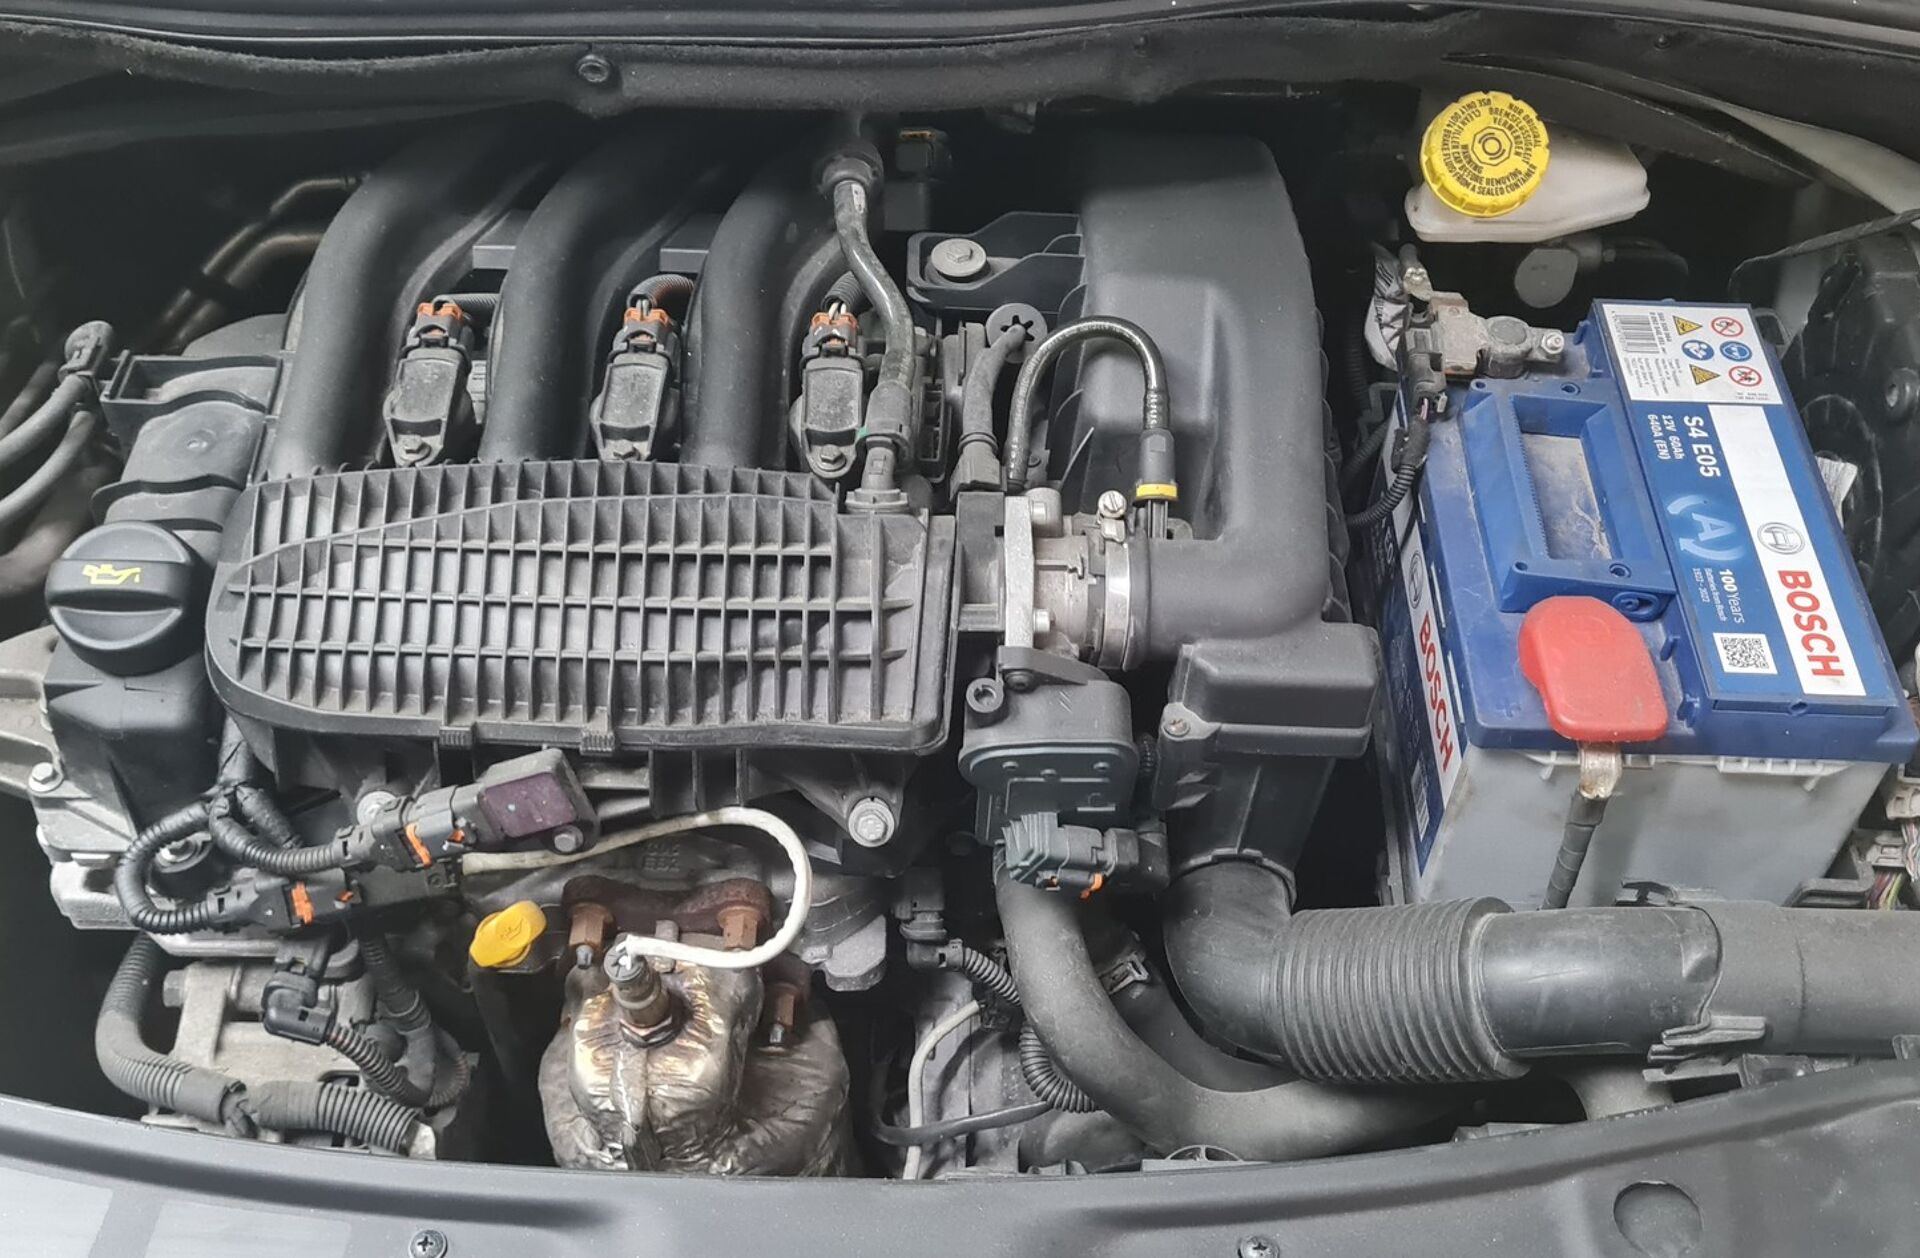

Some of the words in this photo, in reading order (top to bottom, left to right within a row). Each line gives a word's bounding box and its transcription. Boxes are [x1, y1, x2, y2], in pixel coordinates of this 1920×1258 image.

[1459, 109, 1482, 127] CLEAN
[1454, 151, 1464, 165] CAP
[1458, 164, 1485, 185] BEFORE
[1477, 186, 1505, 197] SEALED
[1505, 165, 1537, 193] CONTAINER
[1485, 169, 1522, 187] REMOVING
[1662, 414, 1677, 435] 12V
[1683, 415, 1709, 438] S4
[1647, 414, 1664, 437] 640A
[1656, 440, 1672, 461] (EN)
[1668, 436, 1685, 460] 60Ah
[1692, 444, 1721, 478] E05
[1777, 570, 1845, 677] BOSCH
[1420, 611, 1453, 770] BOSCH
